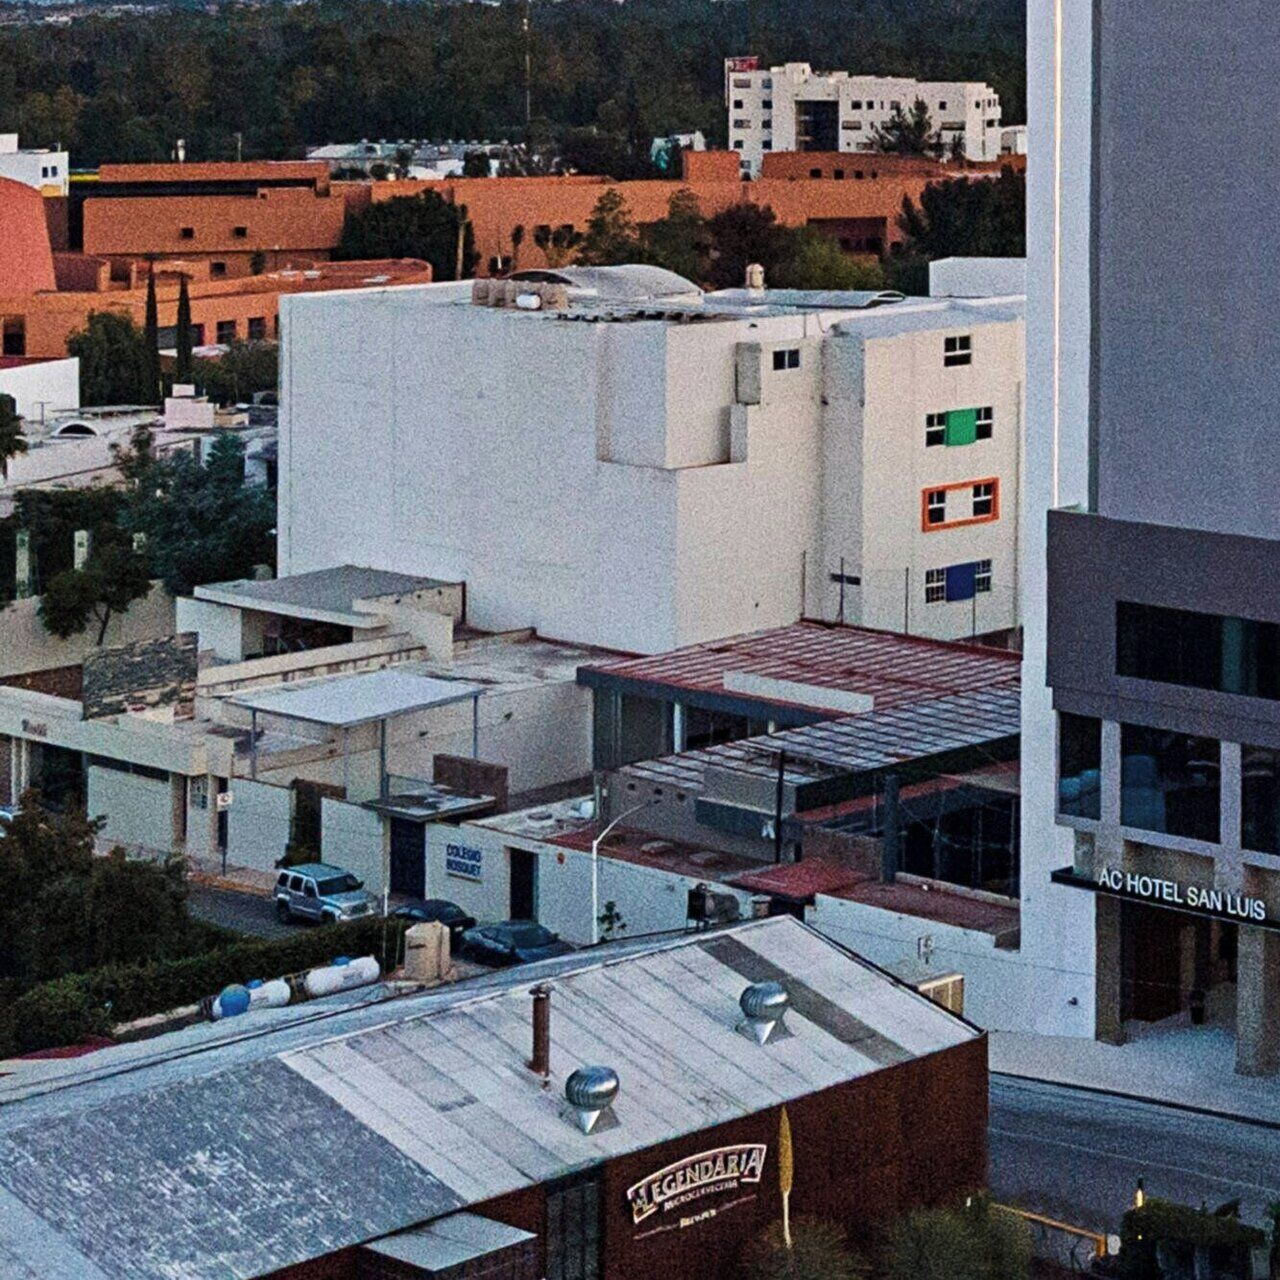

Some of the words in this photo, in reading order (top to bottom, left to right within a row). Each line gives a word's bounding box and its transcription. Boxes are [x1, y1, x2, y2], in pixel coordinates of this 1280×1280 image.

[1098, 868, 1122, 891] AC
[1127, 873, 1183, 904] HOTEL
[1187, 886, 1222, 912] SAN
[1227, 893, 1266, 920] LUIS
